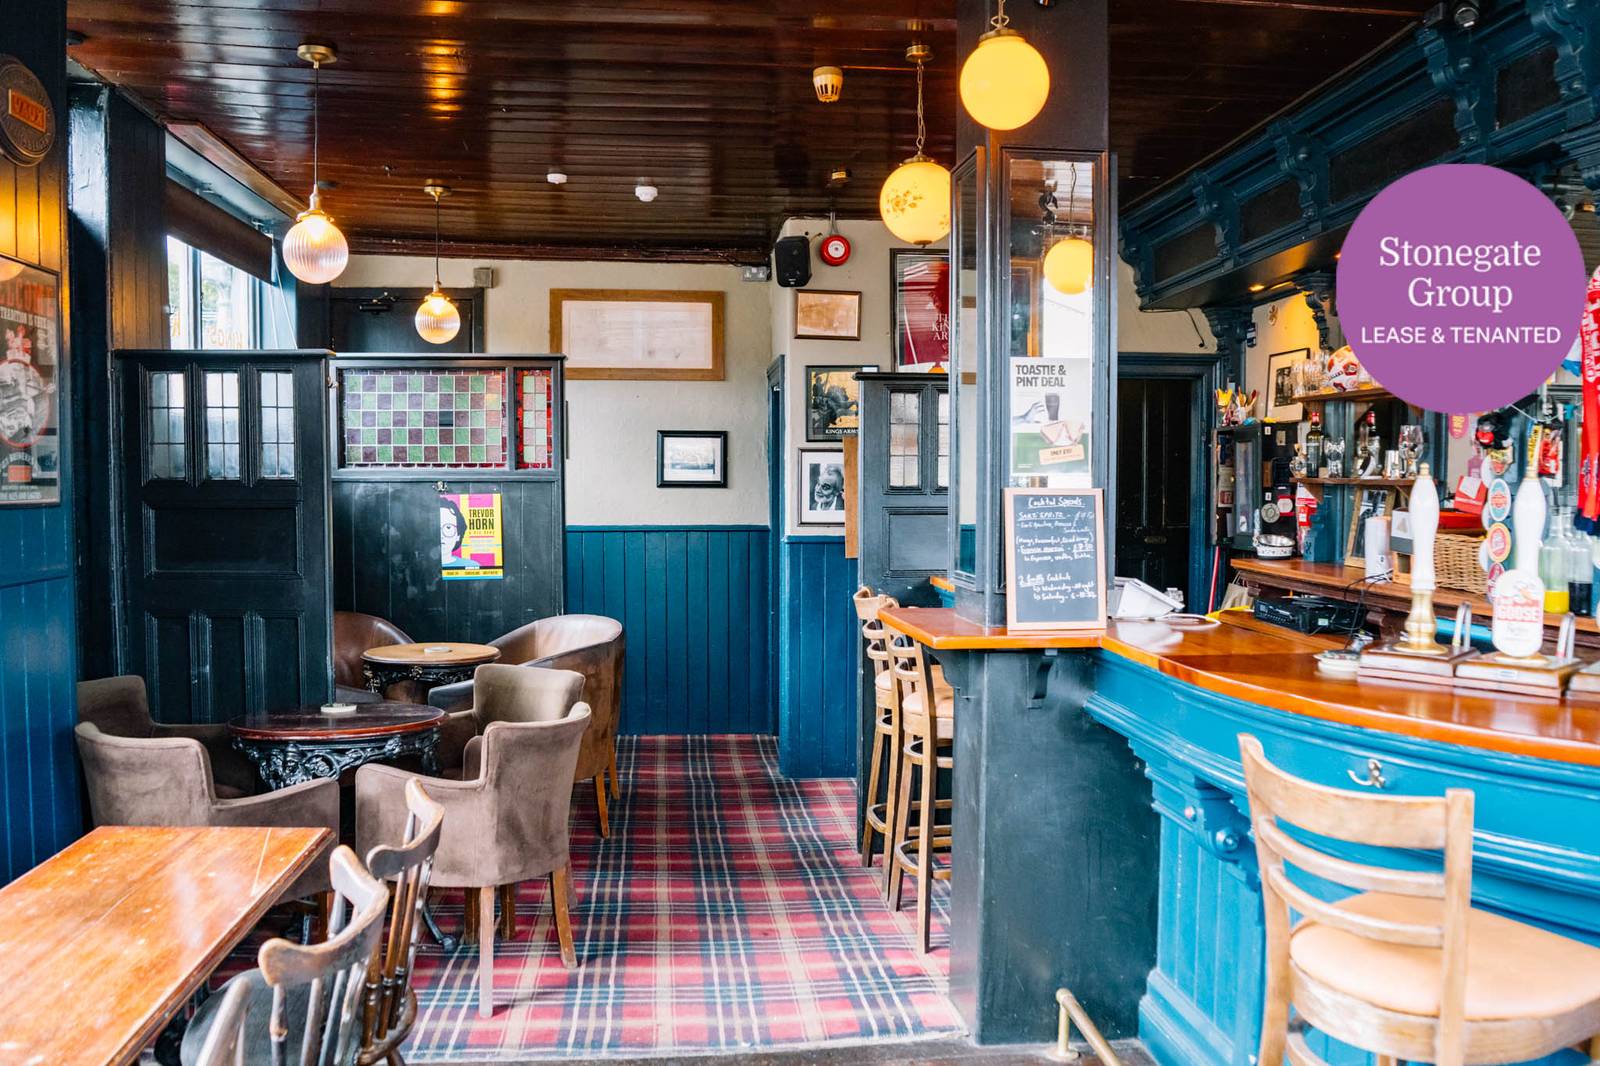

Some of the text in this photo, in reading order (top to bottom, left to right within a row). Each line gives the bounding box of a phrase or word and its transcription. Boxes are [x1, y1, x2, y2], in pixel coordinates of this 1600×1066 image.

[931, 323, 949, 331] KIN
[1015, 364, 1067, 375] TOASTIE &
[1016, 377, 1065, 387] PINT DEAL
[469, 509, 494, 518] TREVOR
[469, 518, 495, 530] HORN
